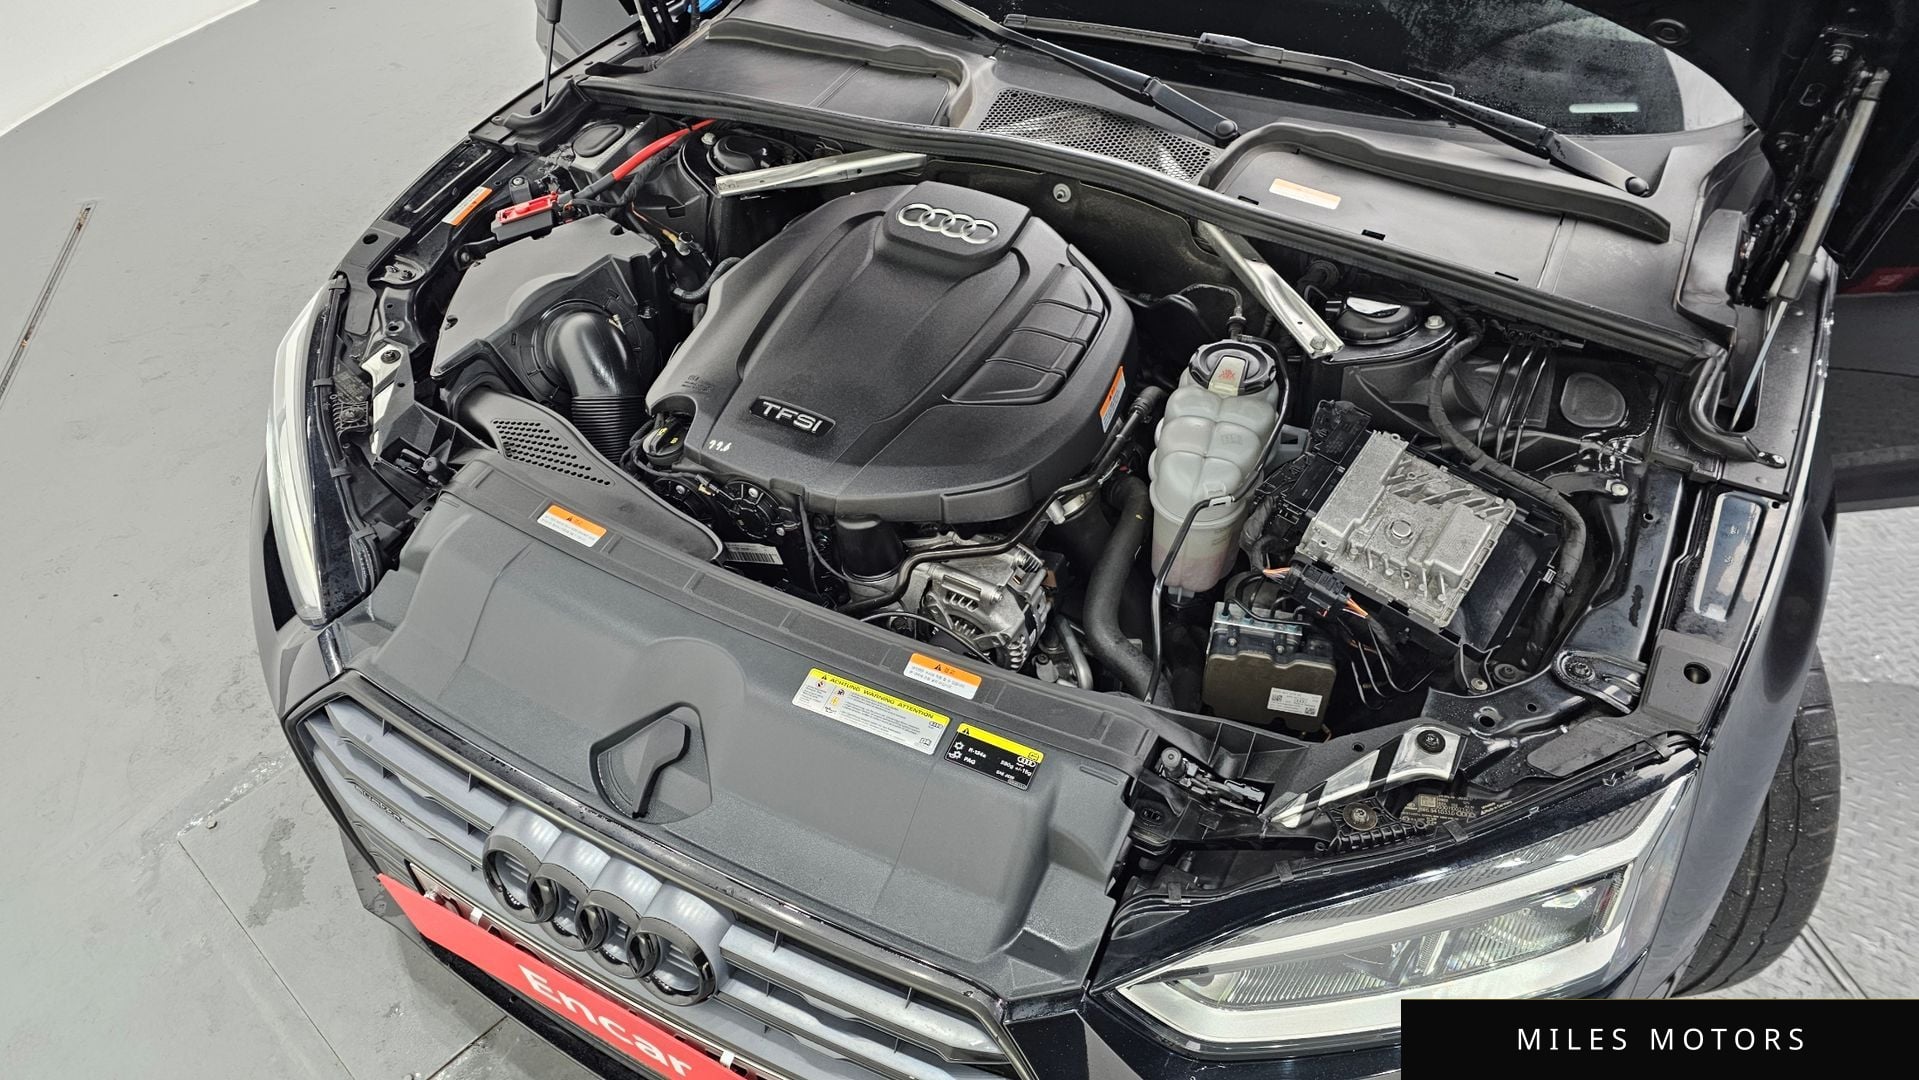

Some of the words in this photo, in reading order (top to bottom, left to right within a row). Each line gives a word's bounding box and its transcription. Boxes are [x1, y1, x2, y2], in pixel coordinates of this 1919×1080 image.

[763, 401, 823, 433] TFSI
[830, 678, 861, 692] ACHTUNG
[864, 689, 895, 705] WARNING
[897, 702, 934, 719] ATTENTION
[518, 964, 693, 1077] Encar
